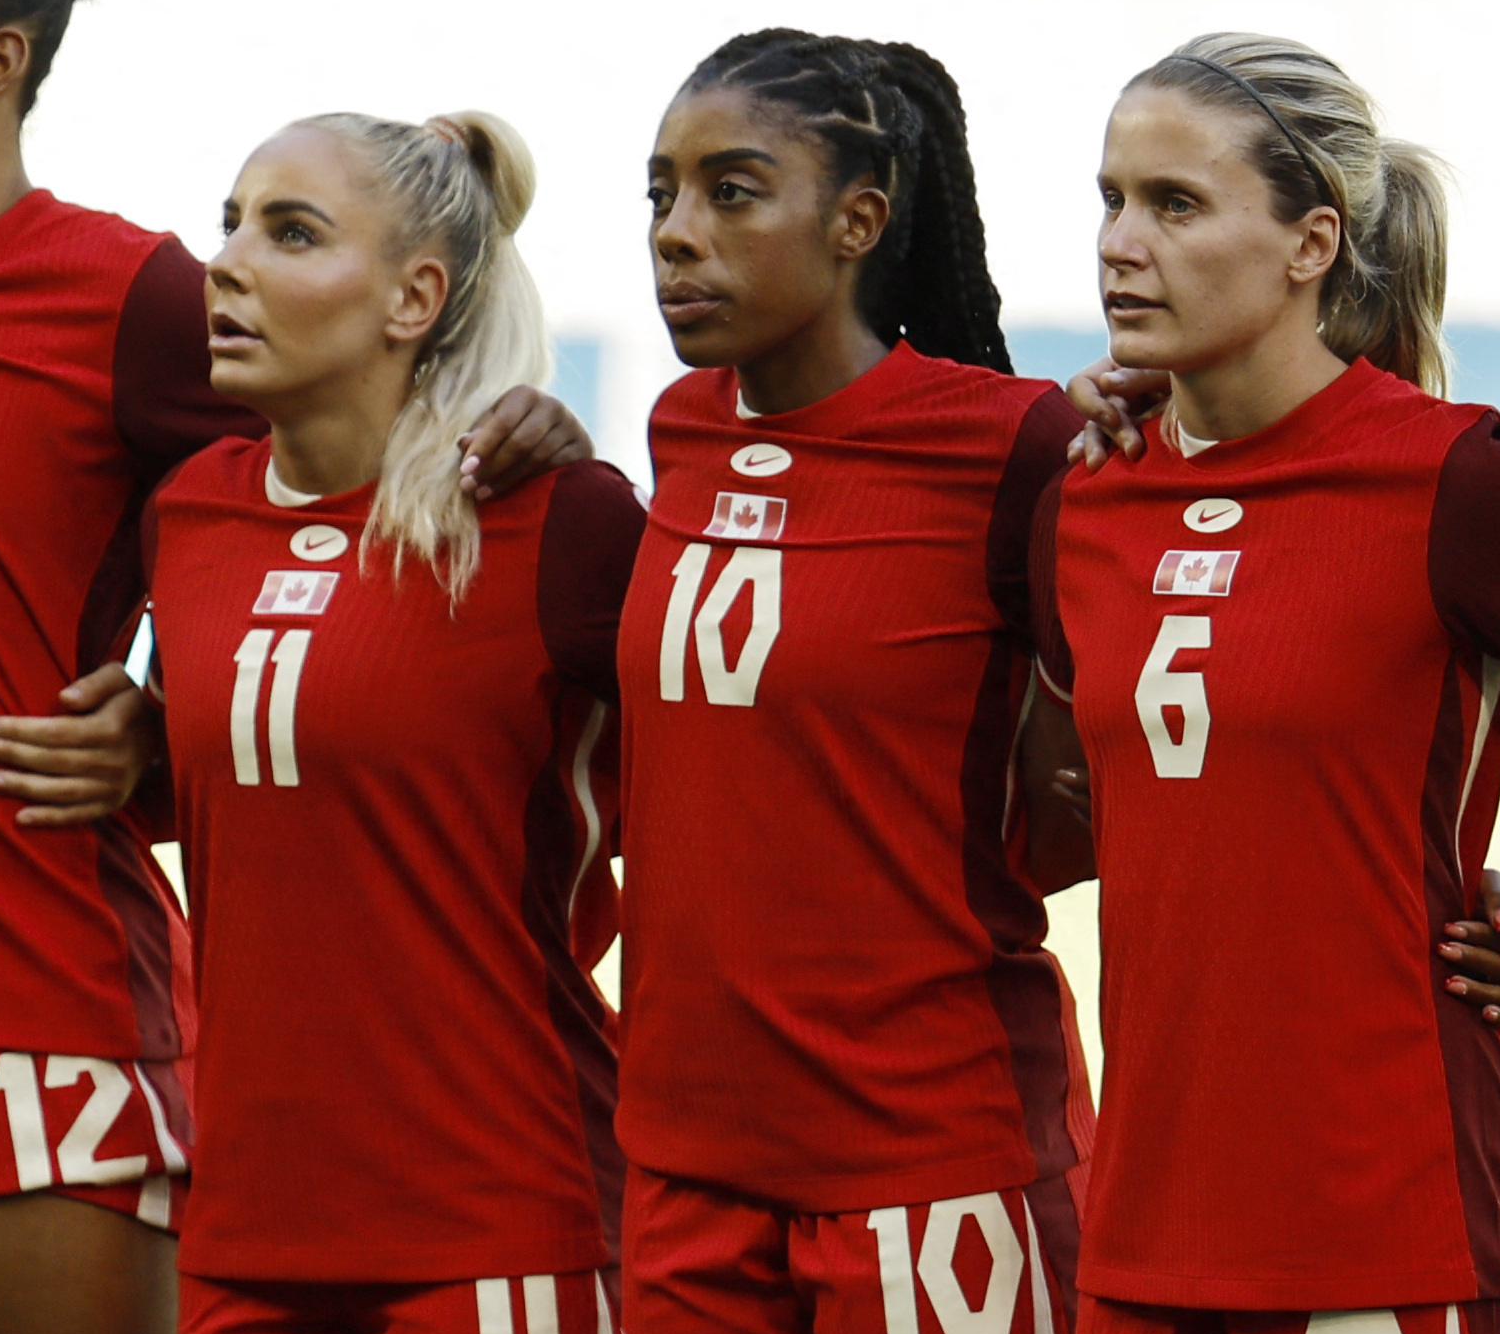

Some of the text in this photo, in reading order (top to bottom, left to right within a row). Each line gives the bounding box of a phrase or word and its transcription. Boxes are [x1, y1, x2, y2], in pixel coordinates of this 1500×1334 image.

[660, 543, 782, 707] 10
[1134, 615, 1211, 779] 6
[231, 629, 311, 787] 11
